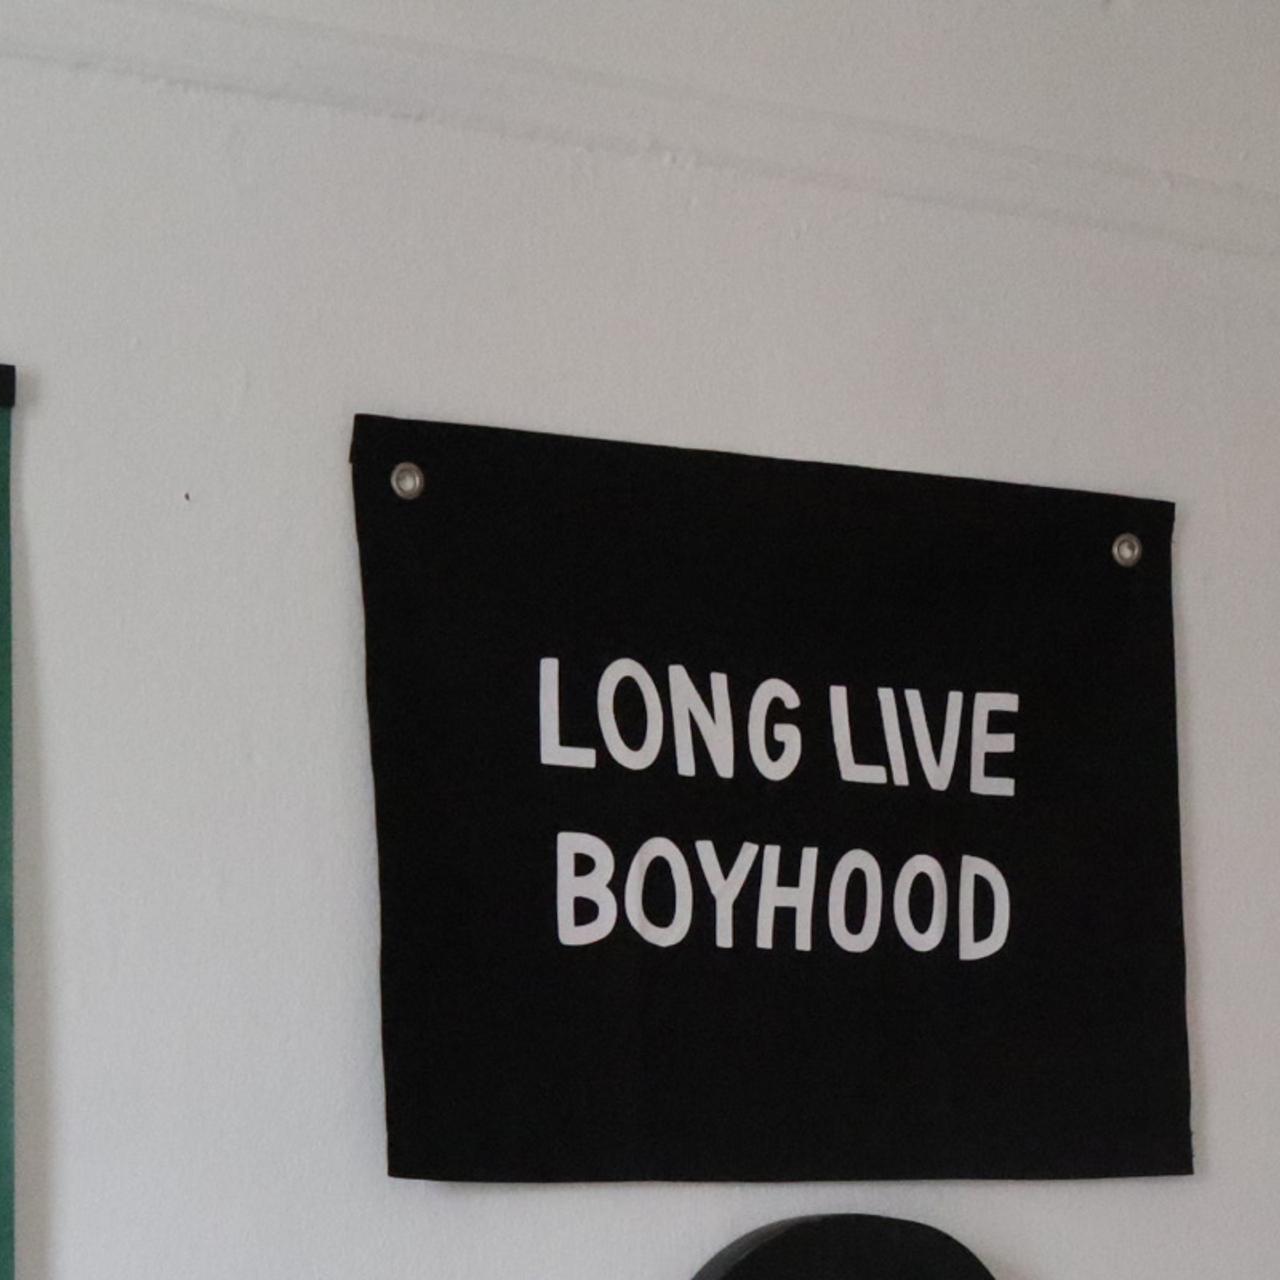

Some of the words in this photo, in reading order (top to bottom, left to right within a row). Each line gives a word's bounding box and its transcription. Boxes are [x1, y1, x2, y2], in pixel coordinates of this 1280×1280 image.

[539, 657, 802, 782] LONG
[829, 685, 1019, 797] LIVE
[556, 831, 1011, 961] BOYHOOD
